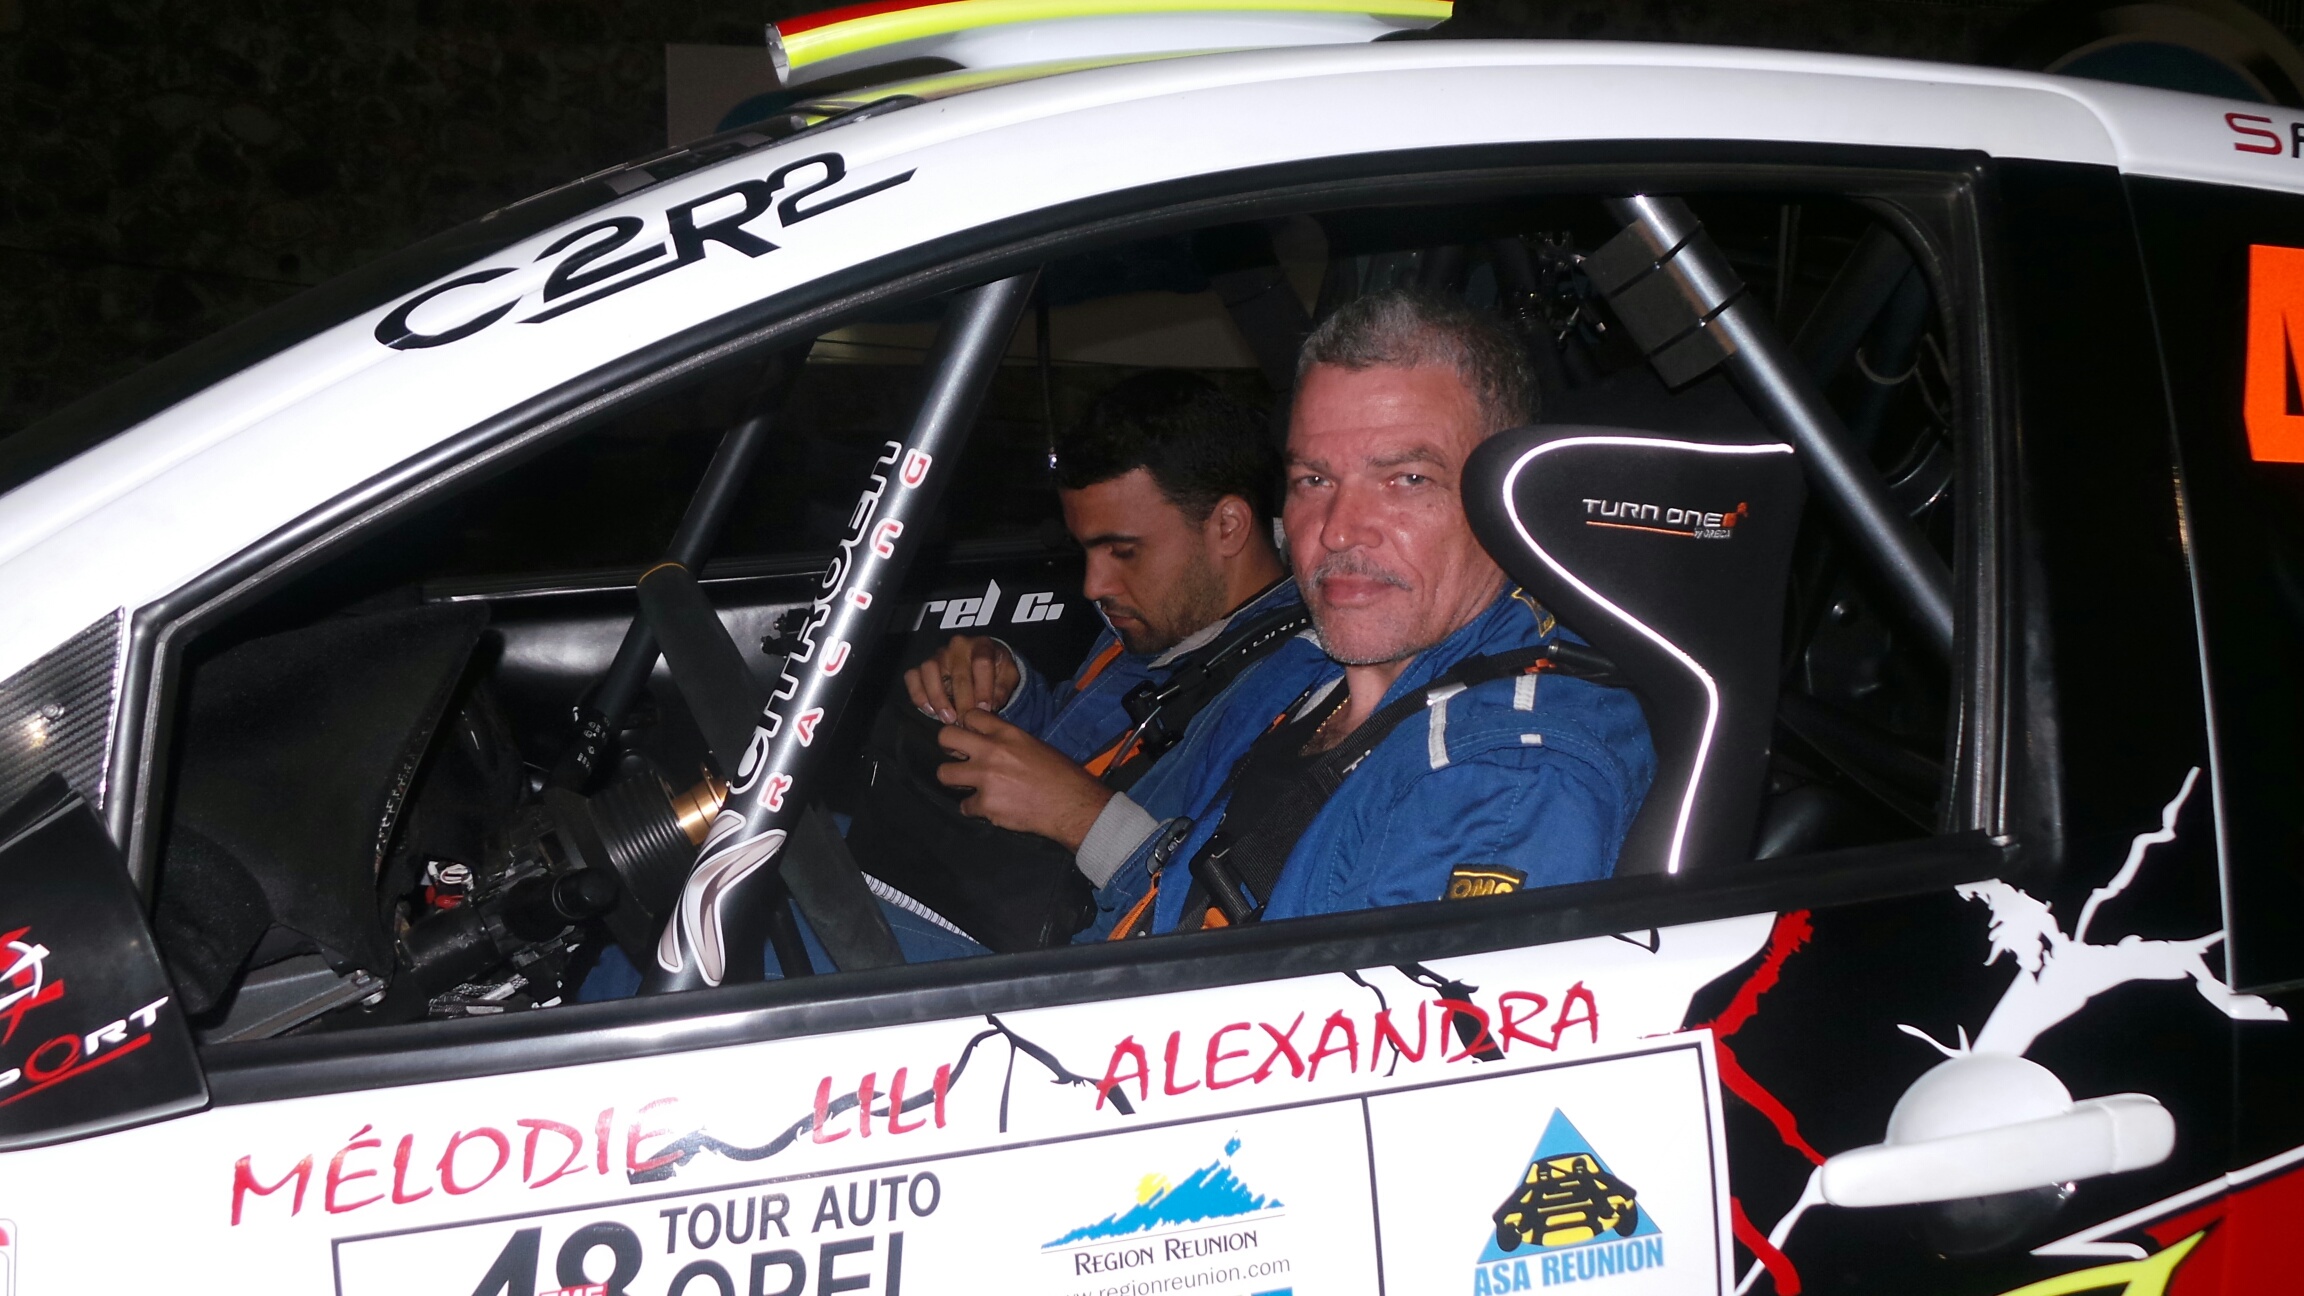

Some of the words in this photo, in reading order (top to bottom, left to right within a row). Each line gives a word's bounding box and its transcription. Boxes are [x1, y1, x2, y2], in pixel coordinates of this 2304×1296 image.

[374, 151, 918, 351] C2R2
[1582, 498, 1661, 521] TURN
[1665, 507, 1724, 528] ONE
[913, 578, 1002, 632] rel
[1095, 980, 1600, 1111] ALEXANDRA
[230, 1096, 684, 1227] MÉLODIE
[812, 1062, 952, 1145] LILI
[659, 1192, 791, 1255] TOUR
[810, 1170, 941, 1234] AUTO
[1074, 1246, 1155, 1276] REGION
[1163, 1229, 1259, 1262] REUNION
[1472, 1258, 1532, 1296] ASA
[1540, 1236, 1665, 1287] REUNION
